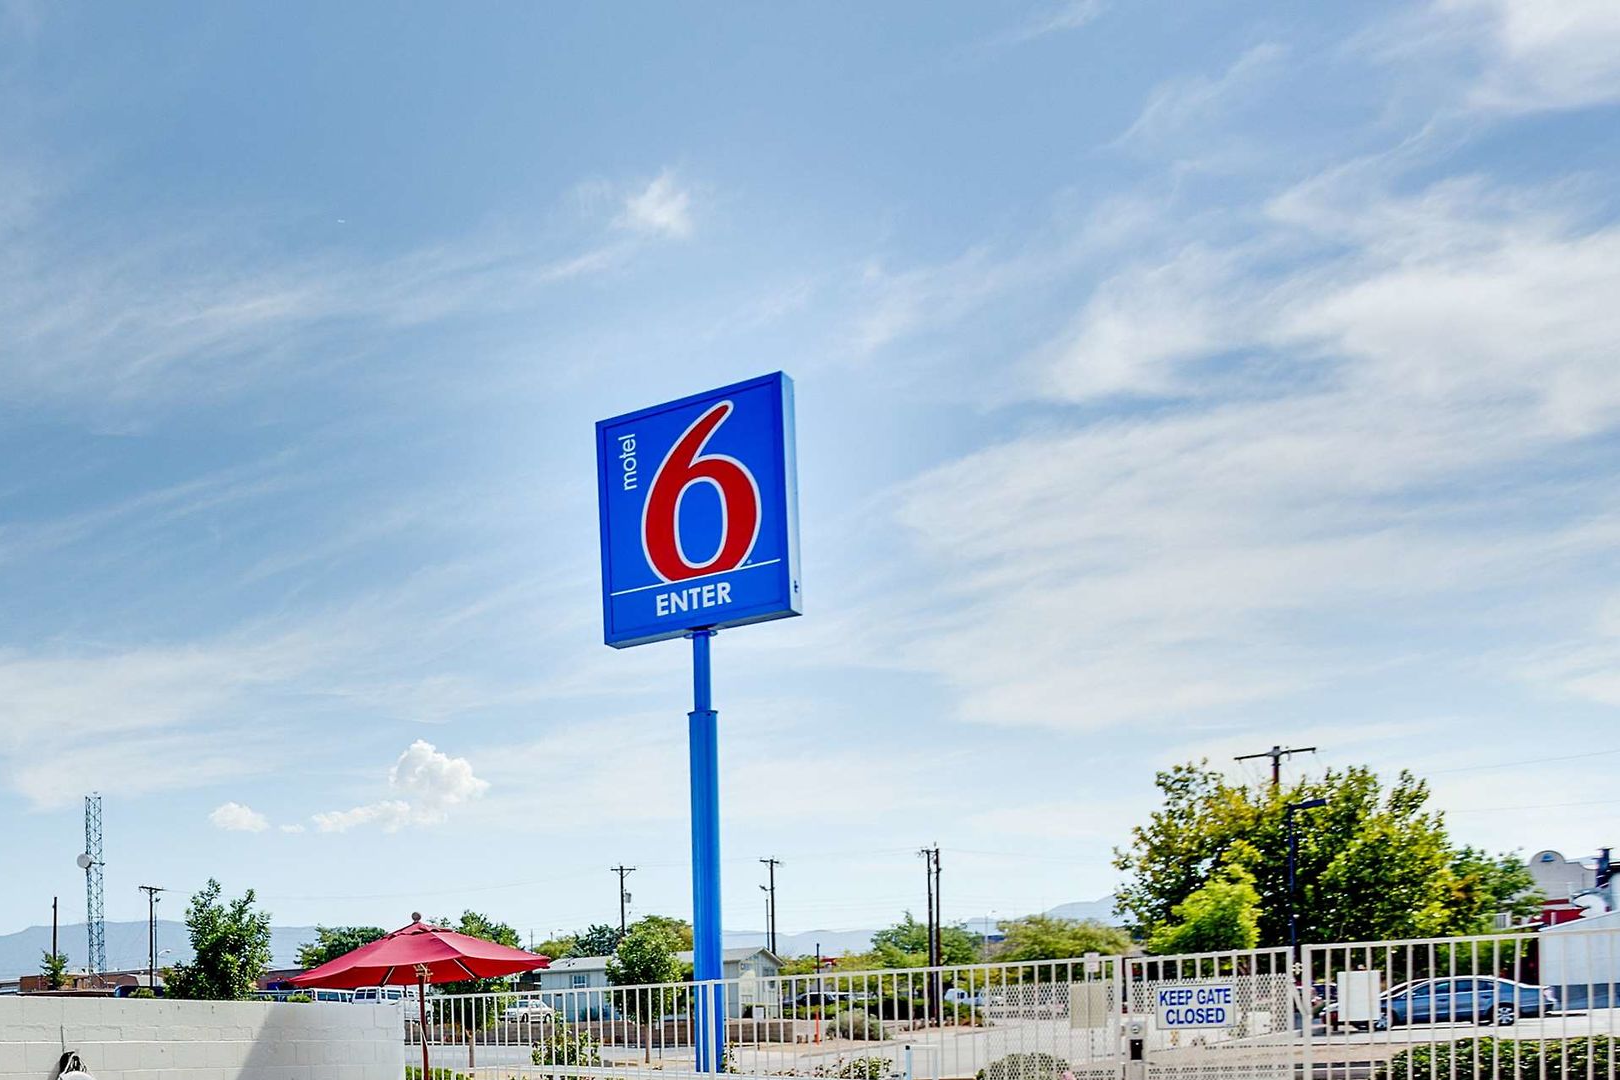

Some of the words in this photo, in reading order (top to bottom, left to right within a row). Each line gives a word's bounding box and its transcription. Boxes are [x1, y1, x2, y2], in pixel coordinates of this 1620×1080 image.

[618, 433, 637, 491] motel
[641, 400, 762, 584] 6
[656, 582, 732, 617] ENTER
[1159, 990, 1193, 1006] KEEP
[1197, 988, 1231, 1005] GATE
[1166, 1008, 1225, 1024] CLOSED
